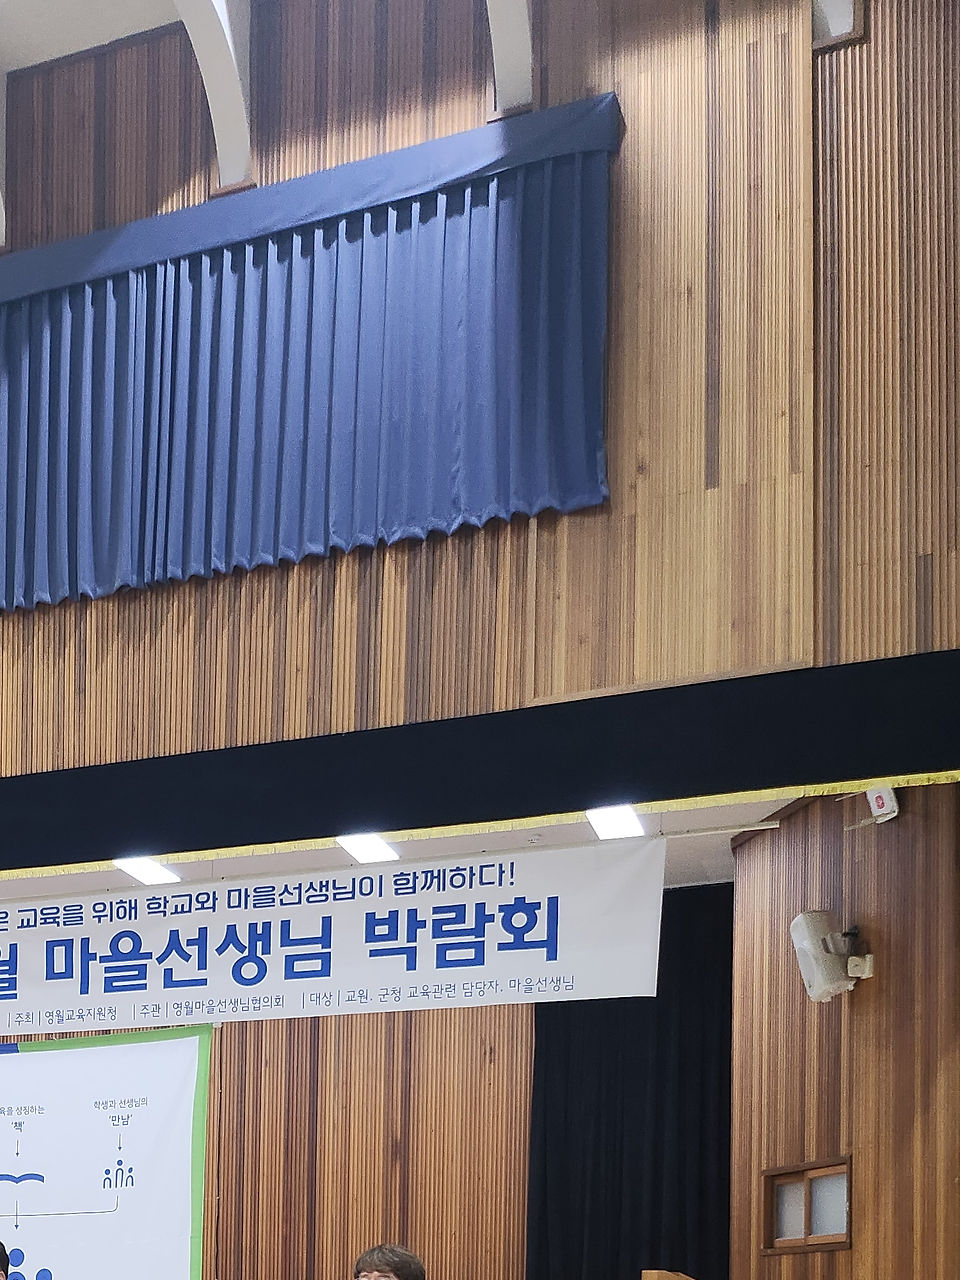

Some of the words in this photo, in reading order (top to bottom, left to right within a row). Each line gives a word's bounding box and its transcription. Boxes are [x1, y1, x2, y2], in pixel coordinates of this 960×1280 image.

[17, 904, 83, 929] 교육을
[92, 899, 138, 924] 위해
[146, 891, 218, 917] 학교와
[227, 874, 383, 910] 마을선생님이
[392, 862, 515, 896] 함께하다!
[45, 915, 332, 995] 마을선생님
[365, 895, 559, 972] 박람회
[140, 1003, 161, 1018] 주관
[172, 995, 285, 1016] 영월마을선생님협의회
[310, 991, 333, 1007] 대상
[378, 986, 402, 1002] 군청
[407, 982, 456, 1000] 교육관련
[509, 975, 575, 994] 마을선생님
[14, 1012, 34, 1026] 주최
[44, 1006, 117, 1025] 영월교육지원청
